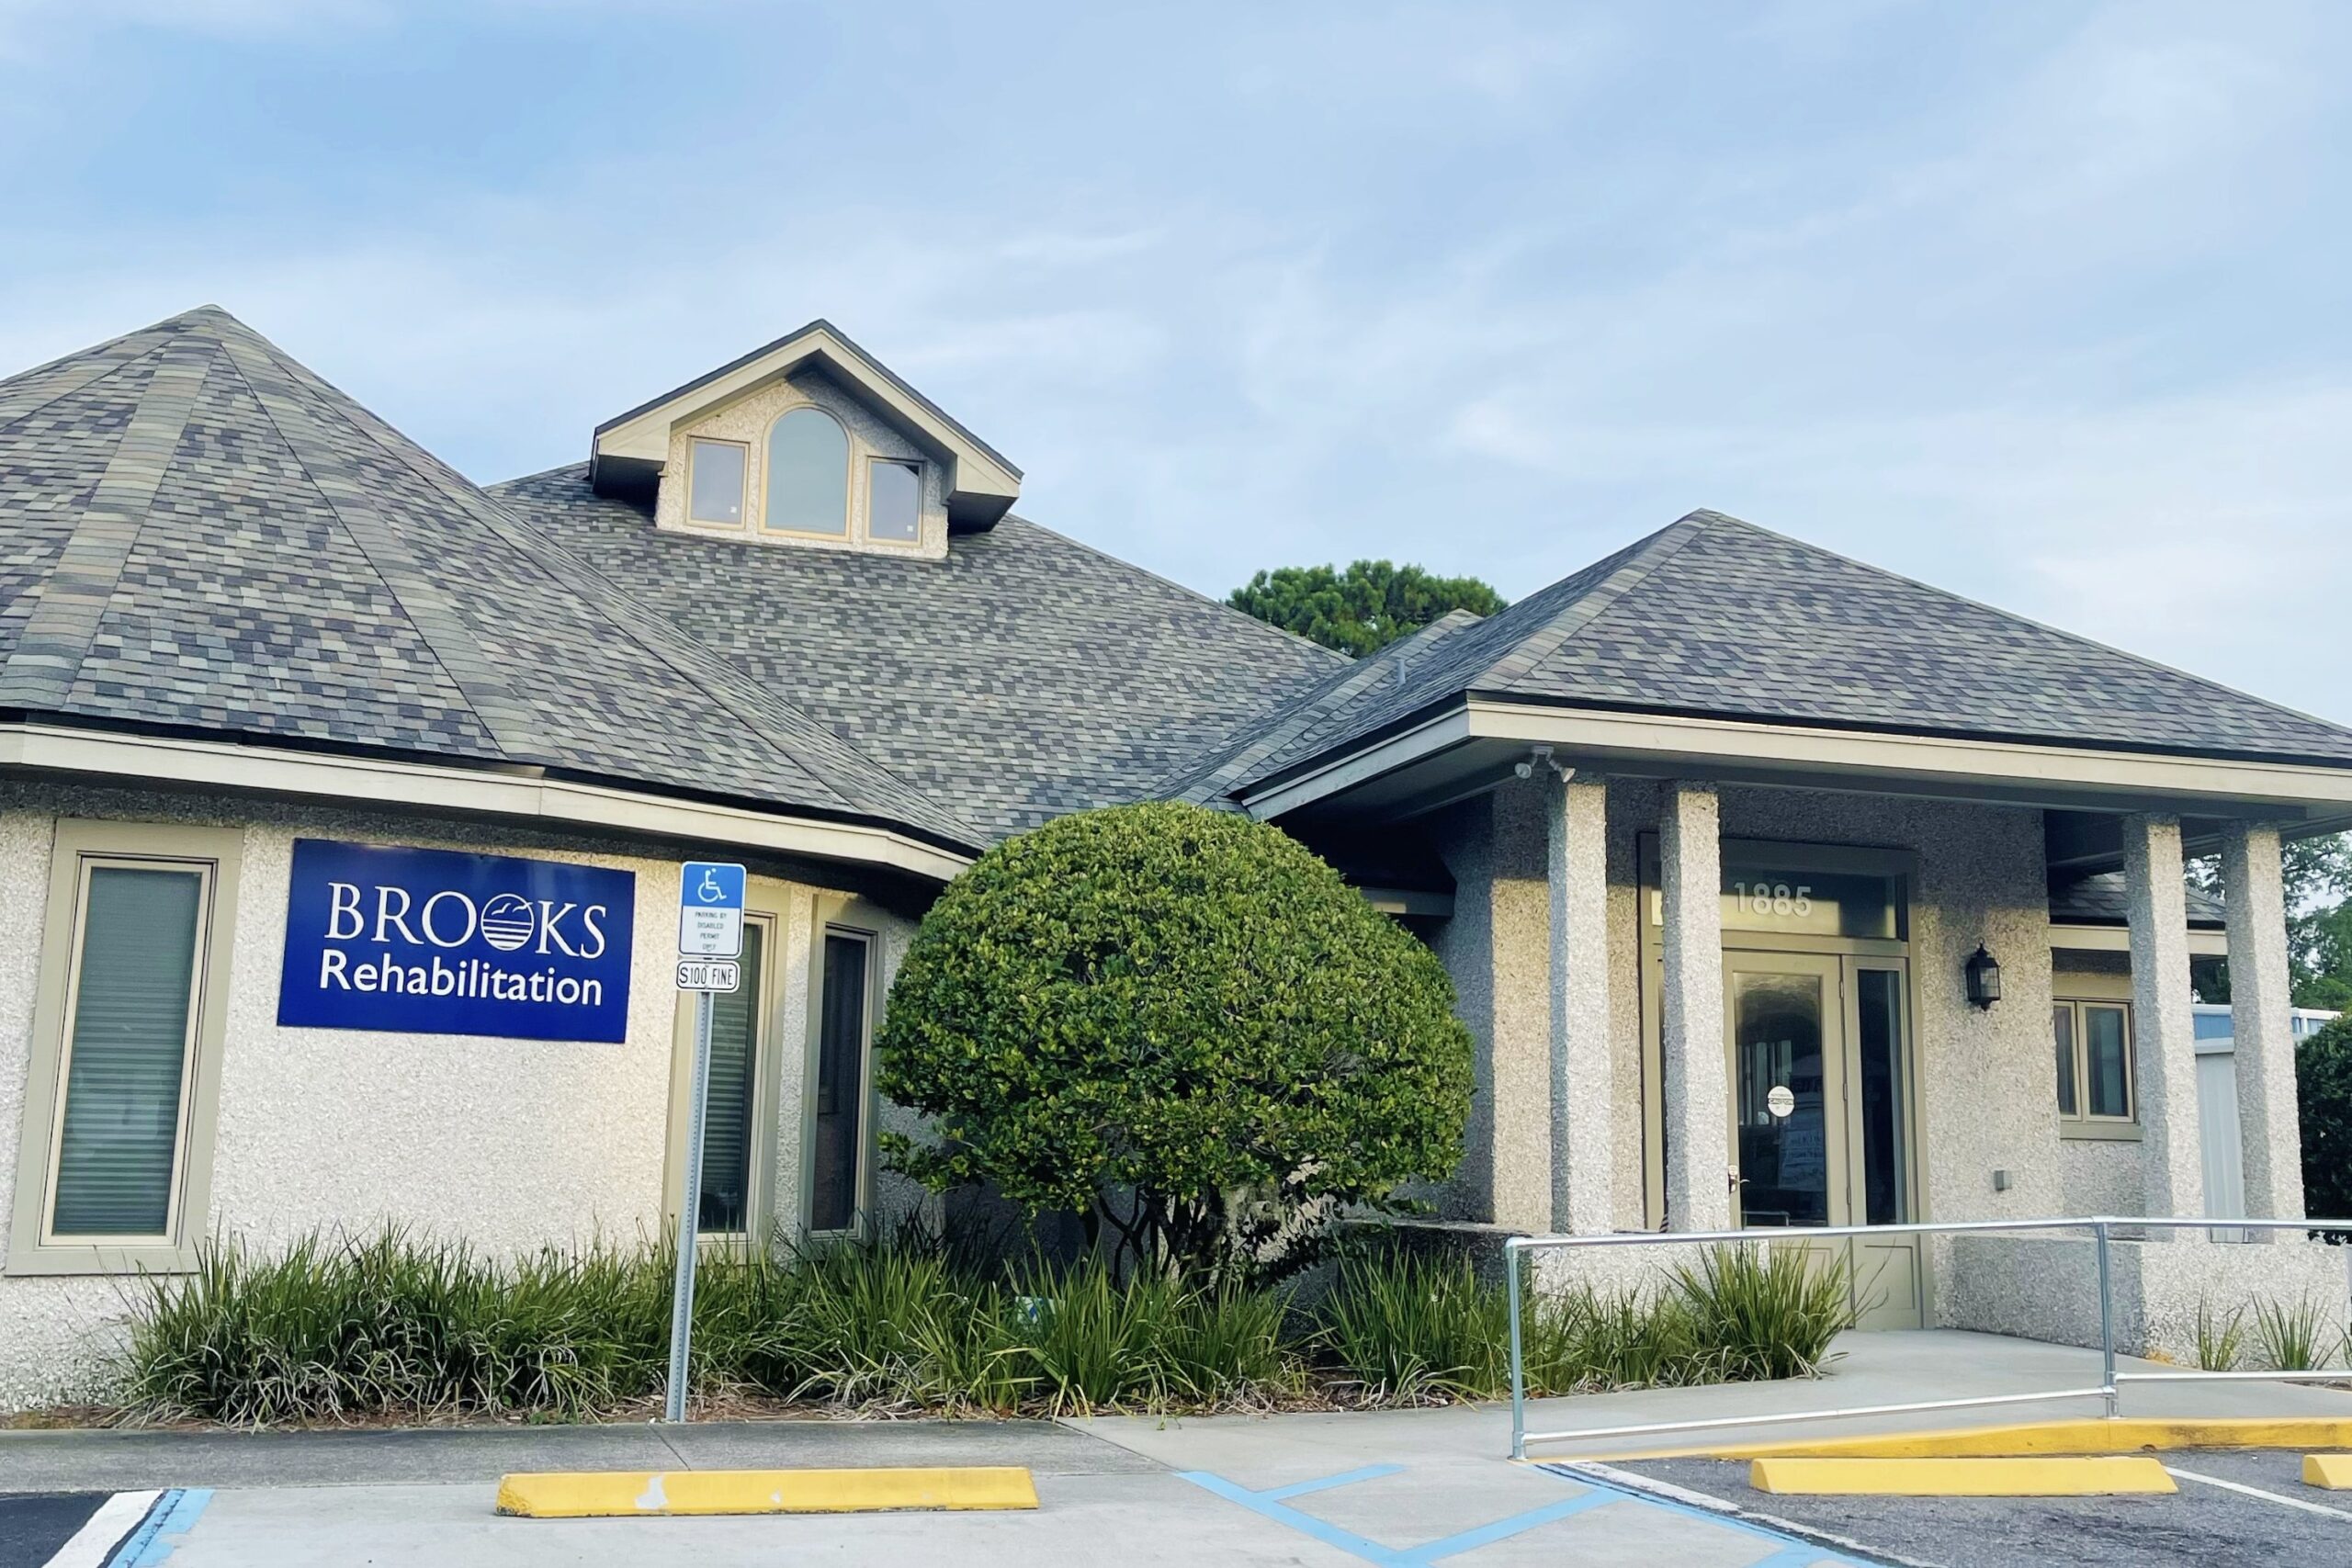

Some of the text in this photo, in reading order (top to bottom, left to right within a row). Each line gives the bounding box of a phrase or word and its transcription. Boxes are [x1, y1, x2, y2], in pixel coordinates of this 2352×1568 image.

[324, 882, 606, 959] BROOKS
[1735, 882, 1812, 917] 1885
[320, 949, 602, 1006] Rehabilitation
[712, 968, 733, 986] FINE
